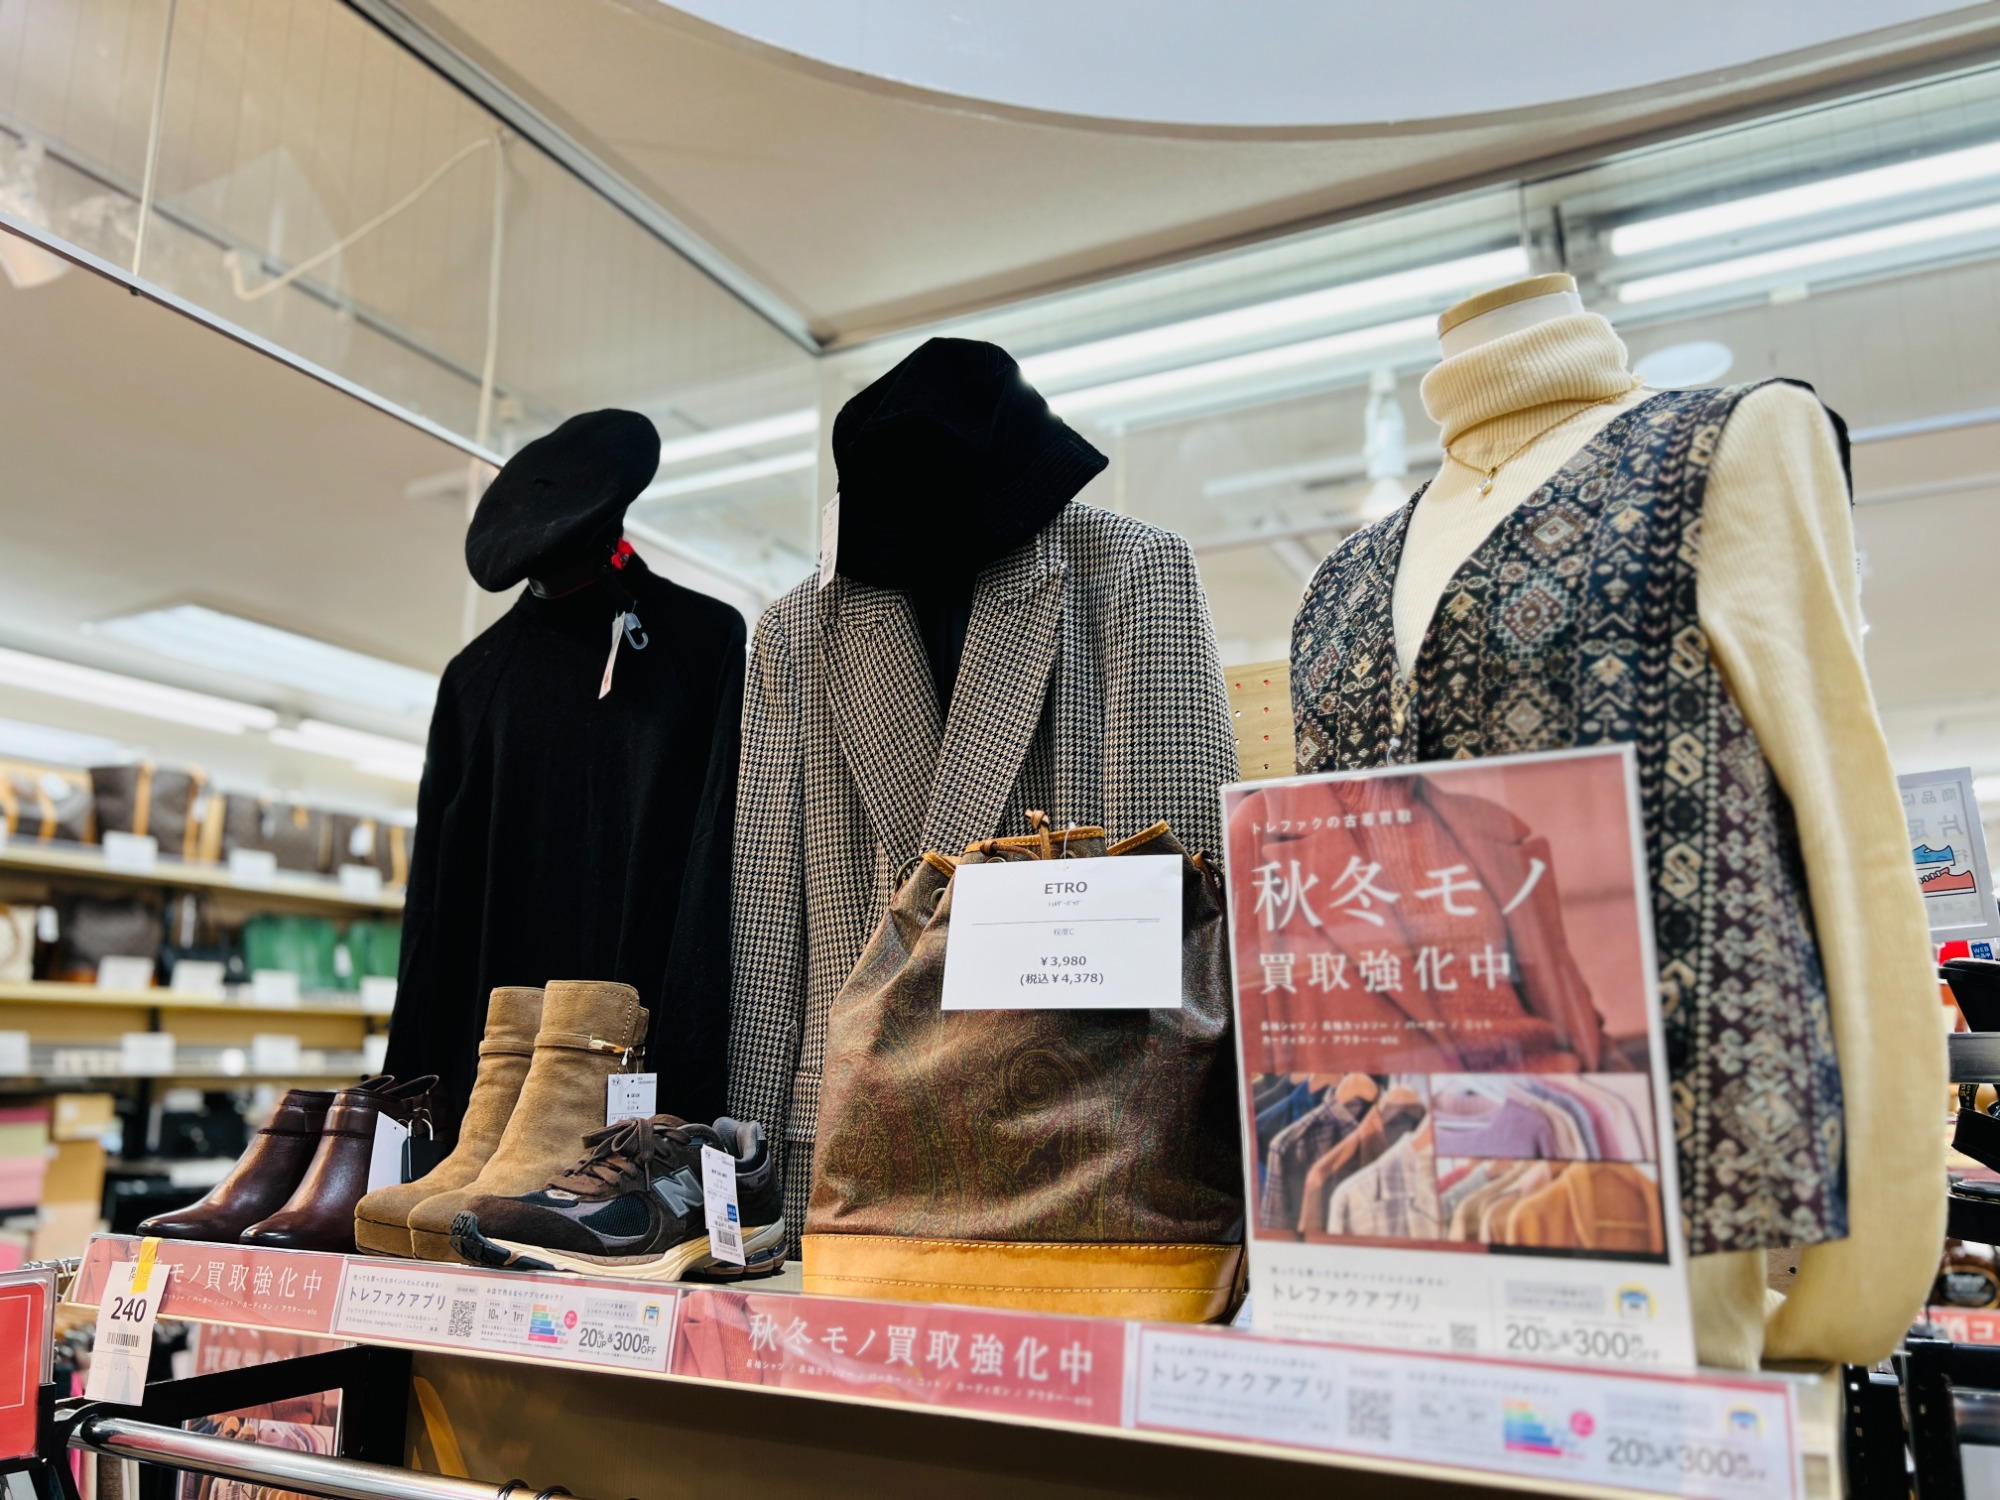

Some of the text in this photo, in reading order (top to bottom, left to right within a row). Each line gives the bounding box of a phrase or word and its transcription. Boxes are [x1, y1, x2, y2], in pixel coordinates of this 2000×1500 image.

[1044, 881, 1088, 894] ETRO
[1250, 854, 1547, 932] 秋冬モノ
[1258, 943, 1512, 996] 買取強化中
[130, 1254, 323, 1300] モノ買取強化中
[349, 1286, 446, 1311] トレファクアプリ
[111, 1296, 147, 1323] 240
[748, 1310, 1094, 1385] 秋冬モノ買取強化中
